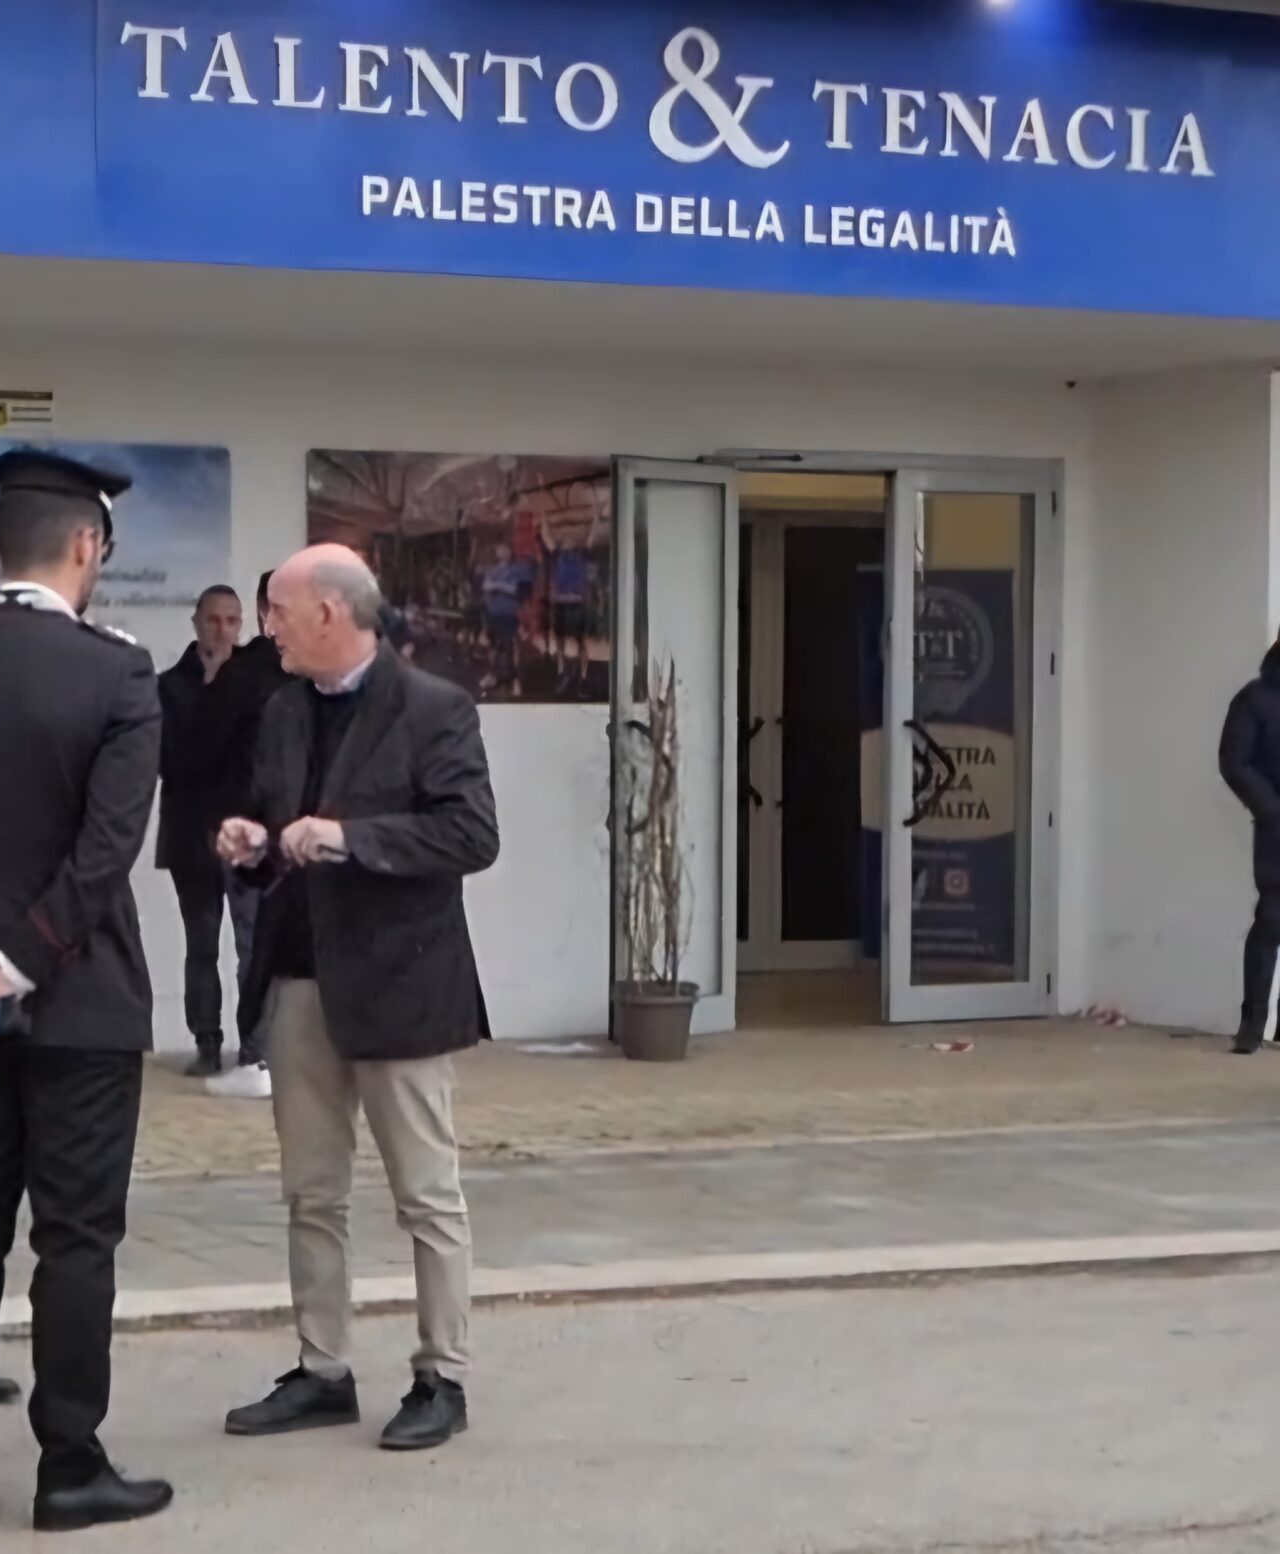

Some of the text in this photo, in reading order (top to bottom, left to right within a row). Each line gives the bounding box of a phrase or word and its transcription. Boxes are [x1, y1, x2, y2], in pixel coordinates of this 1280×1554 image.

[120, 22, 1216, 177] TALENTO & TENACIA
[361, 175, 1017, 257] PALESTRA DELLA LEGALITÀ
